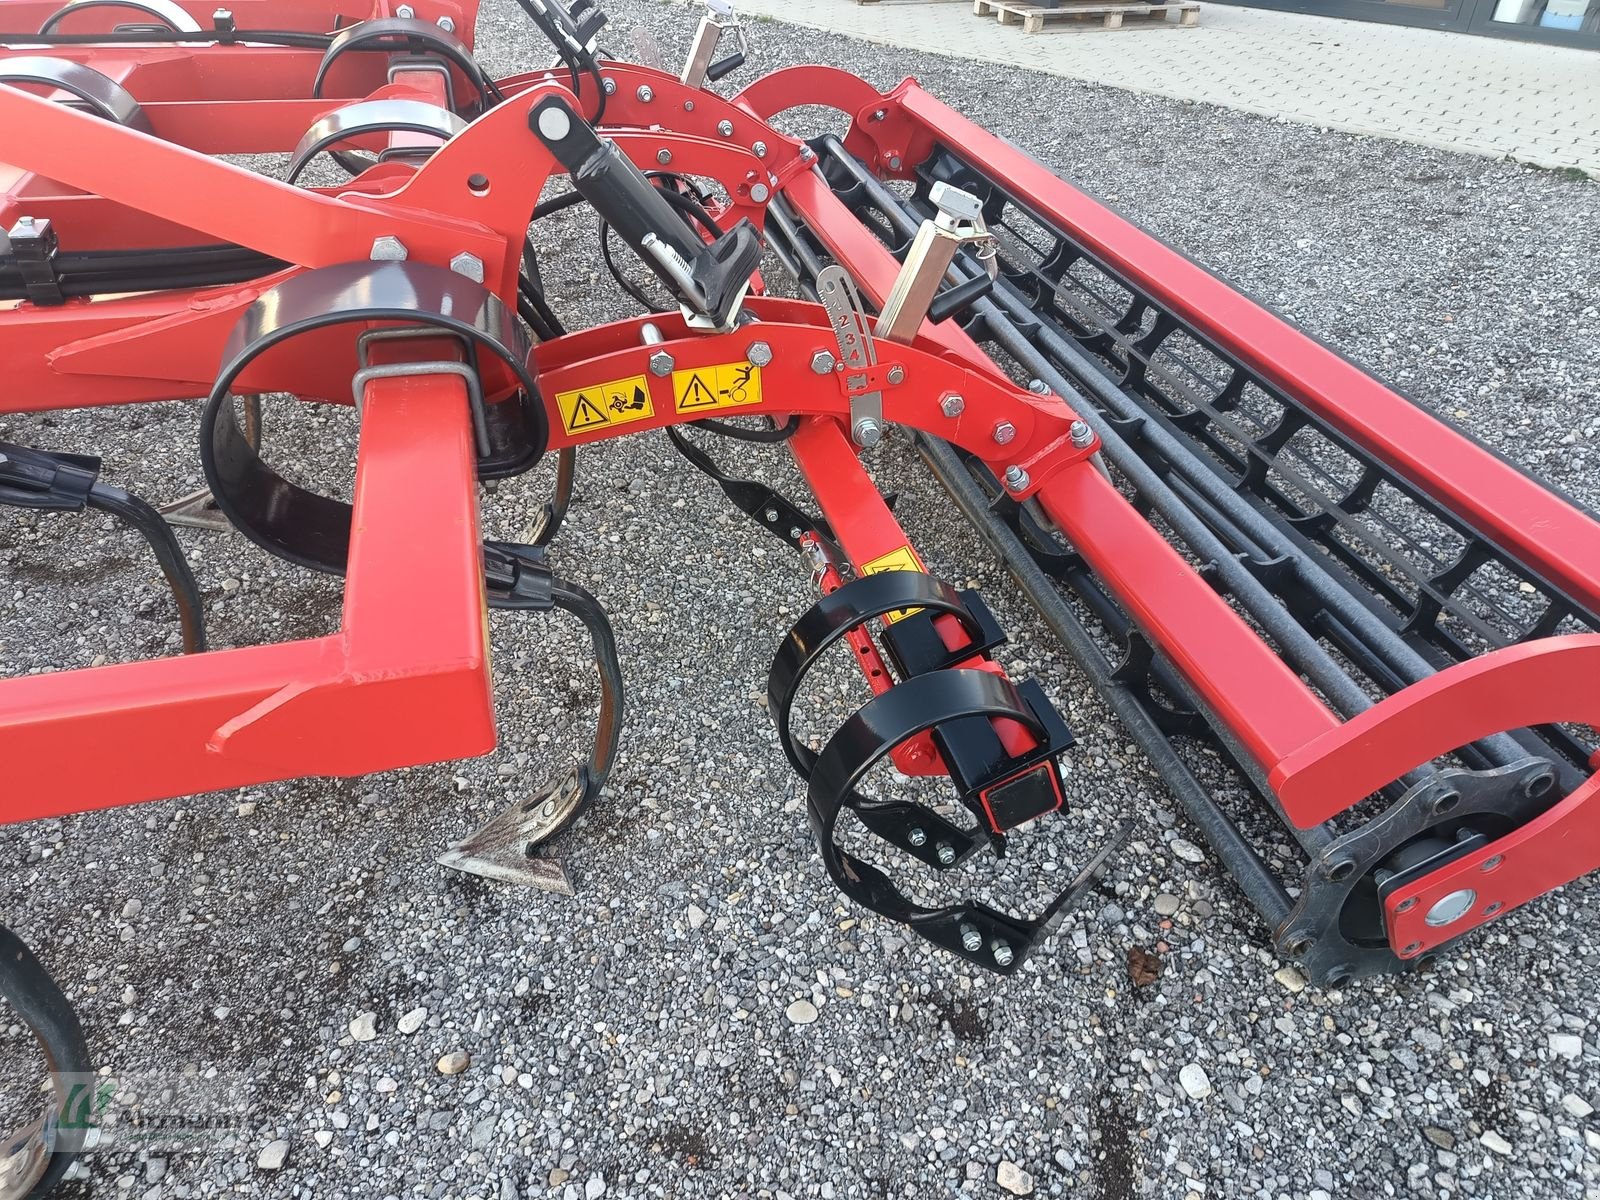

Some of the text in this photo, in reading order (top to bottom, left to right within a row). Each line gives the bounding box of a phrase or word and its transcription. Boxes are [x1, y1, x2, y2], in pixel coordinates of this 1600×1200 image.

[838, 314, 850, 329] 2
[844, 333, 856, 345] 3
[849, 348, 860, 361] 4
